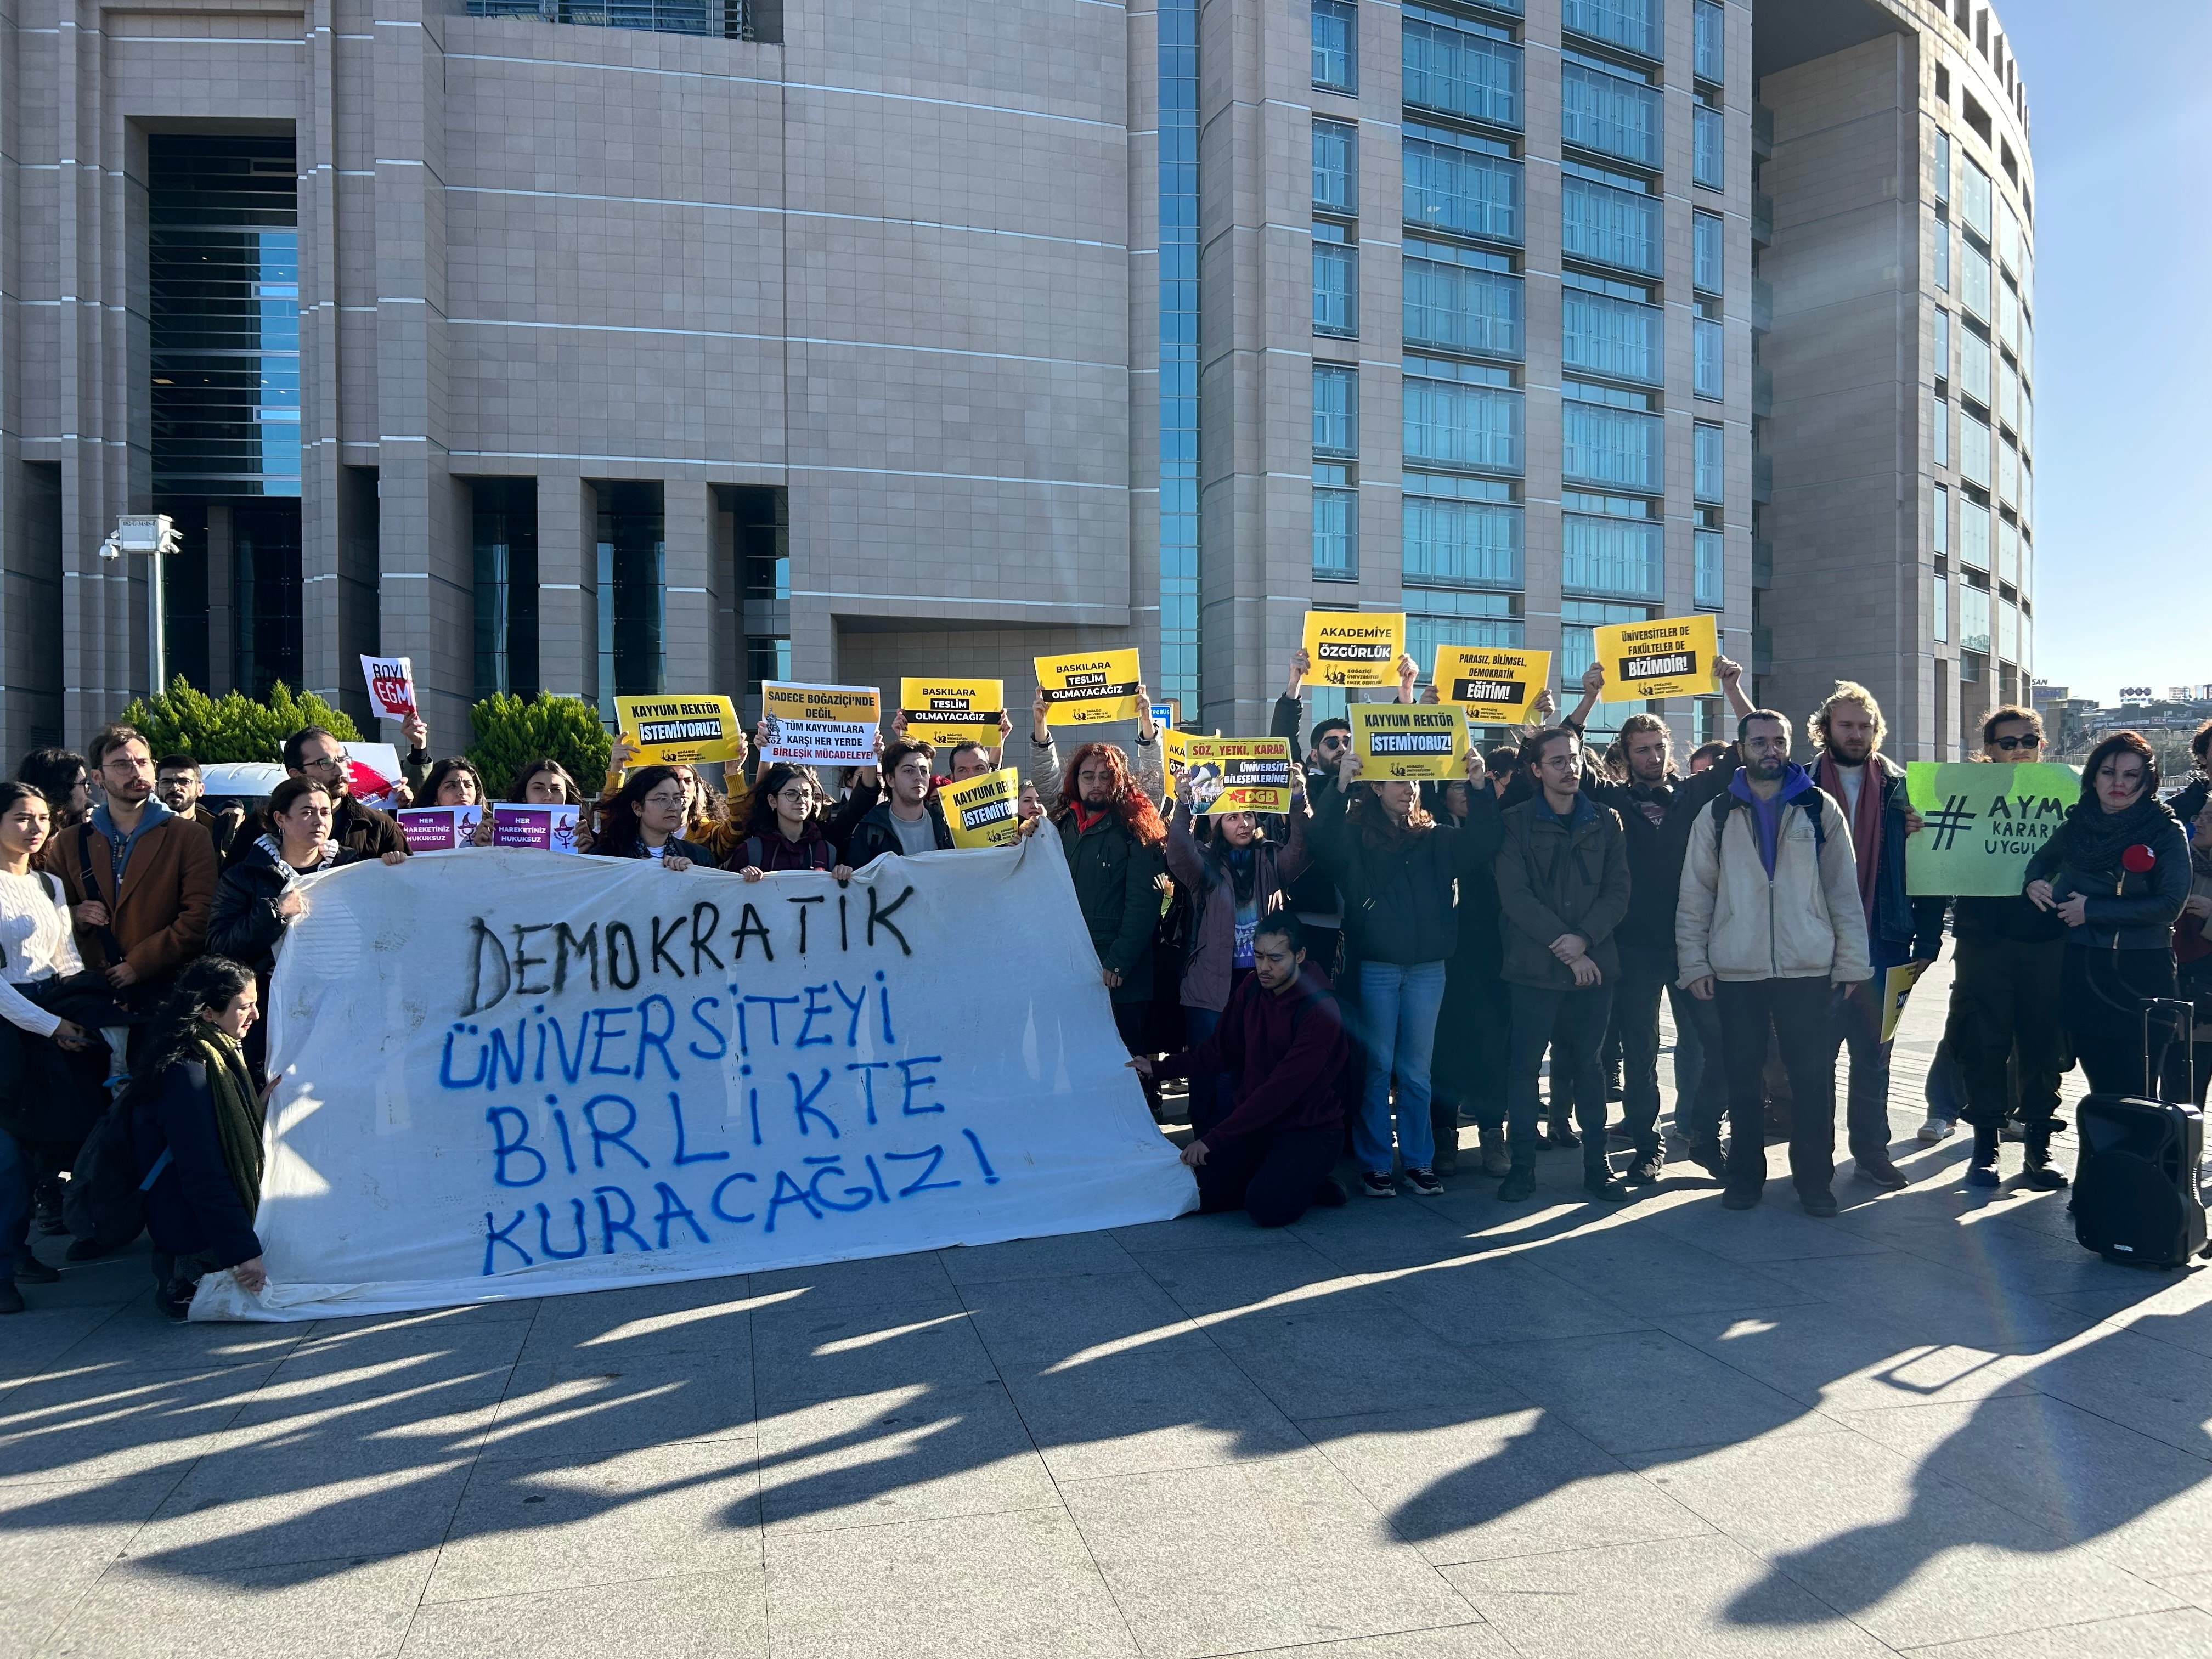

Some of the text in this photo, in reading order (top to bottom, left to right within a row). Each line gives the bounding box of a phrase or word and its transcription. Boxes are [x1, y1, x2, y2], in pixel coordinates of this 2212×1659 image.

[1320, 626, 1391, 637] AKADEMİYE
[1622, 626, 1689, 642] ÜNİVERSİTELER DE
[1319, 644, 1390, 658] ÖZGÜRLÜK
[1628, 641, 1685, 655] FAKÜLTELER DE
[1056, 662, 1111, 673] BASKILARA
[1459, 654, 1527, 667] PARASIZ, BİLİMSEL,
[1628, 655, 1688, 677] BİZİMDİR!
[373, 663, 411, 682] BOYU
[1069, 673, 1103, 685] TESLİM
[1469, 668, 1514, 679] DEMOKRATİK
[377, 682, 413, 706] EĞM
[769, 691, 804, 703] SADECE
[1052, 685, 1123, 699] OLMAYACAĞIZ
[1467, 681, 1510, 701] EĞİTİM!
[631, 702, 721, 718] KAYYUM REKTÖR
[933, 699, 967, 708] TESLİM
[806, 707, 836, 721] DEĞİL,
[915, 712, 985, 721] OLMAYACAĞIZ
[1364, 713, 1453, 727] KAYYUM REKTÖR
[640, 721, 721, 741] İSTEMİYORUZ!
[785, 720, 864, 733] TÜM KAYYUMLARA
[787, 736, 812, 747] KARŞI
[834, 738, 862, 746] YERDE
[1371, 733, 1452, 751] İSTEMİYORUZ!
[773, 746, 873, 759] BİRLEŞİK MÜCADELEYE!
[1193, 743, 1285, 756] SÖZ, YETKİ, KARAR
[1240, 761, 1288, 772] ÜNİVERSİTE
[1224, 774, 1288, 784] BİLEŞENLERİNE!
[953, 784, 995, 806] KAYYUM
[1245, 791, 1276, 803] DGB
[962, 802, 1015, 827] İSTEMİYO
[1988, 795, 2064, 821] AYM
[499, 826, 546, 834] HAREKETİNİZ
[1984, 840, 2036, 854] UYGUL
[460, 879, 914, 1017] DEMOKRATİK
[439, 971, 895, 1090] ÜNİVERSİTEYİ
[486, 1055, 944, 1187] BİRLİKTE
[482, 1128, 1000, 1276] KURACAĞIZ!
